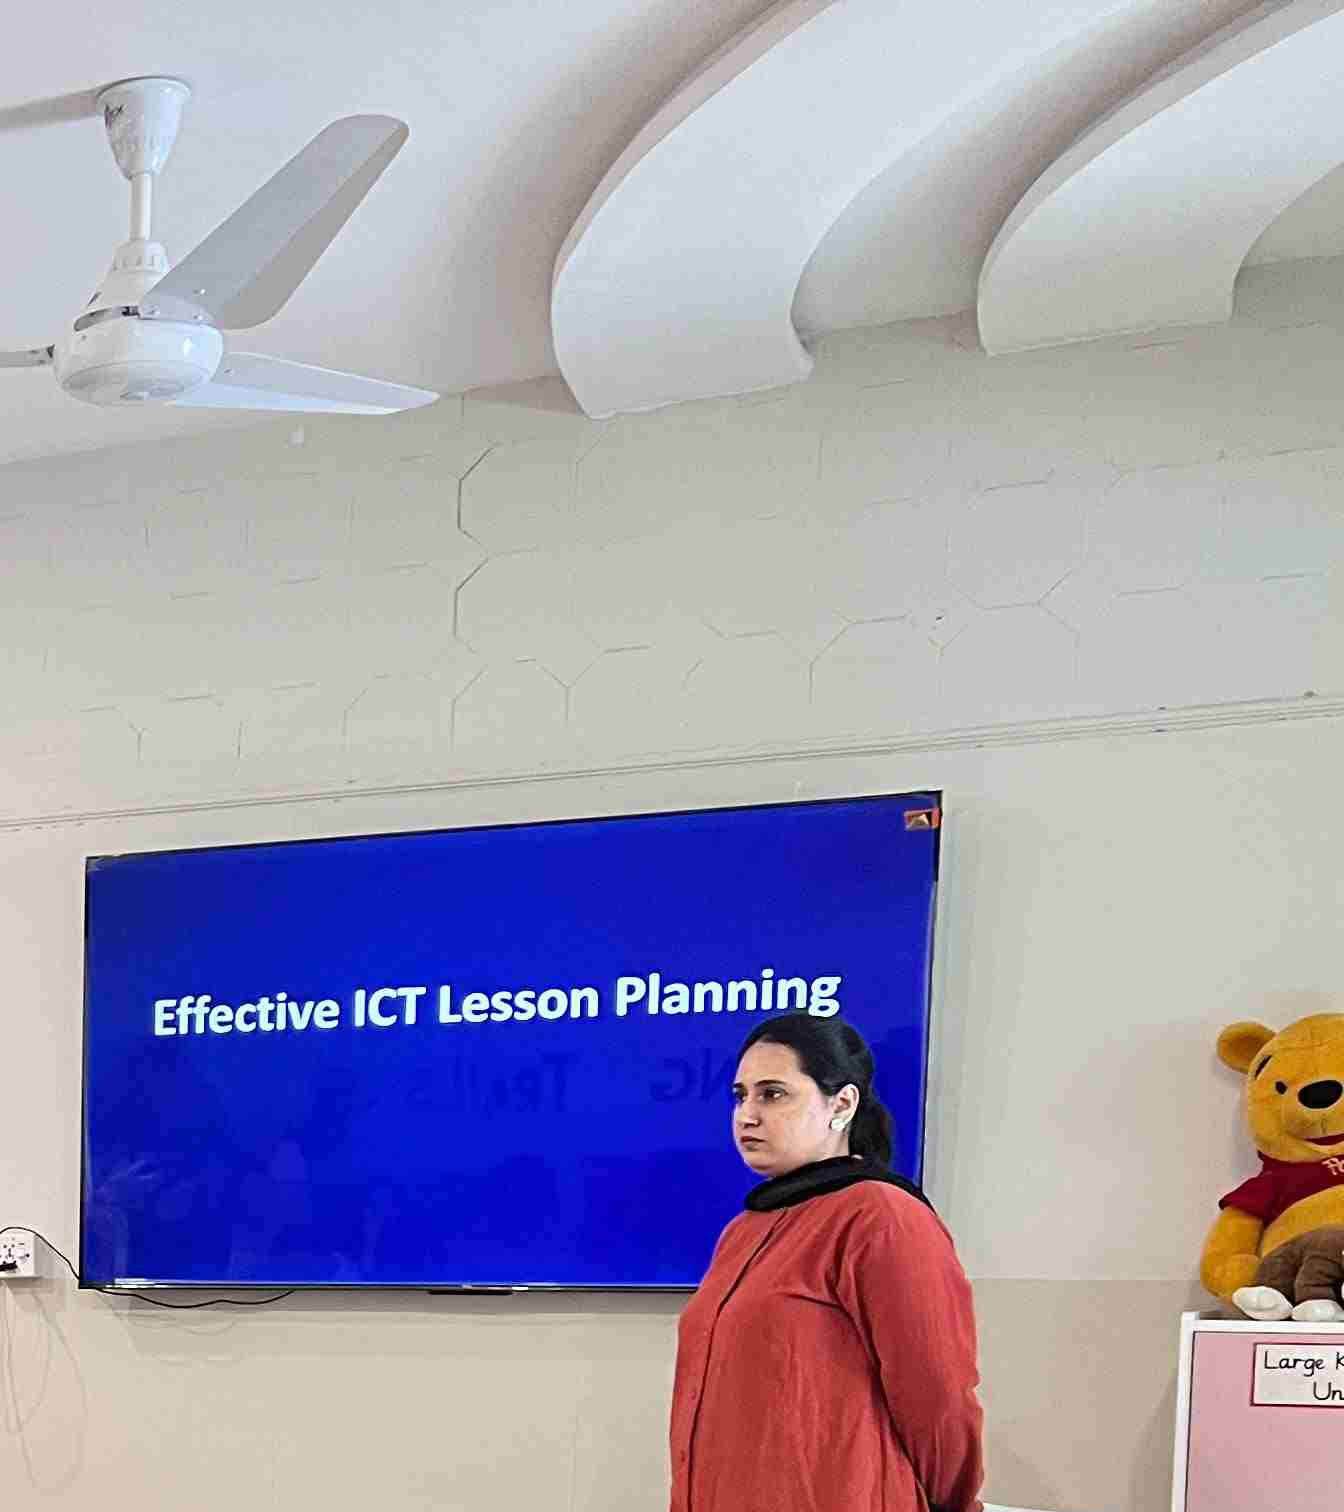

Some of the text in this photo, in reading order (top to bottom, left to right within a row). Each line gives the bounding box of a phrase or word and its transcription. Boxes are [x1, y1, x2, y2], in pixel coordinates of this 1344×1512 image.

[153, 967, 842, 1037] Effective ICT Lesson Planning
[1263, 1350, 1326, 1378] Large
